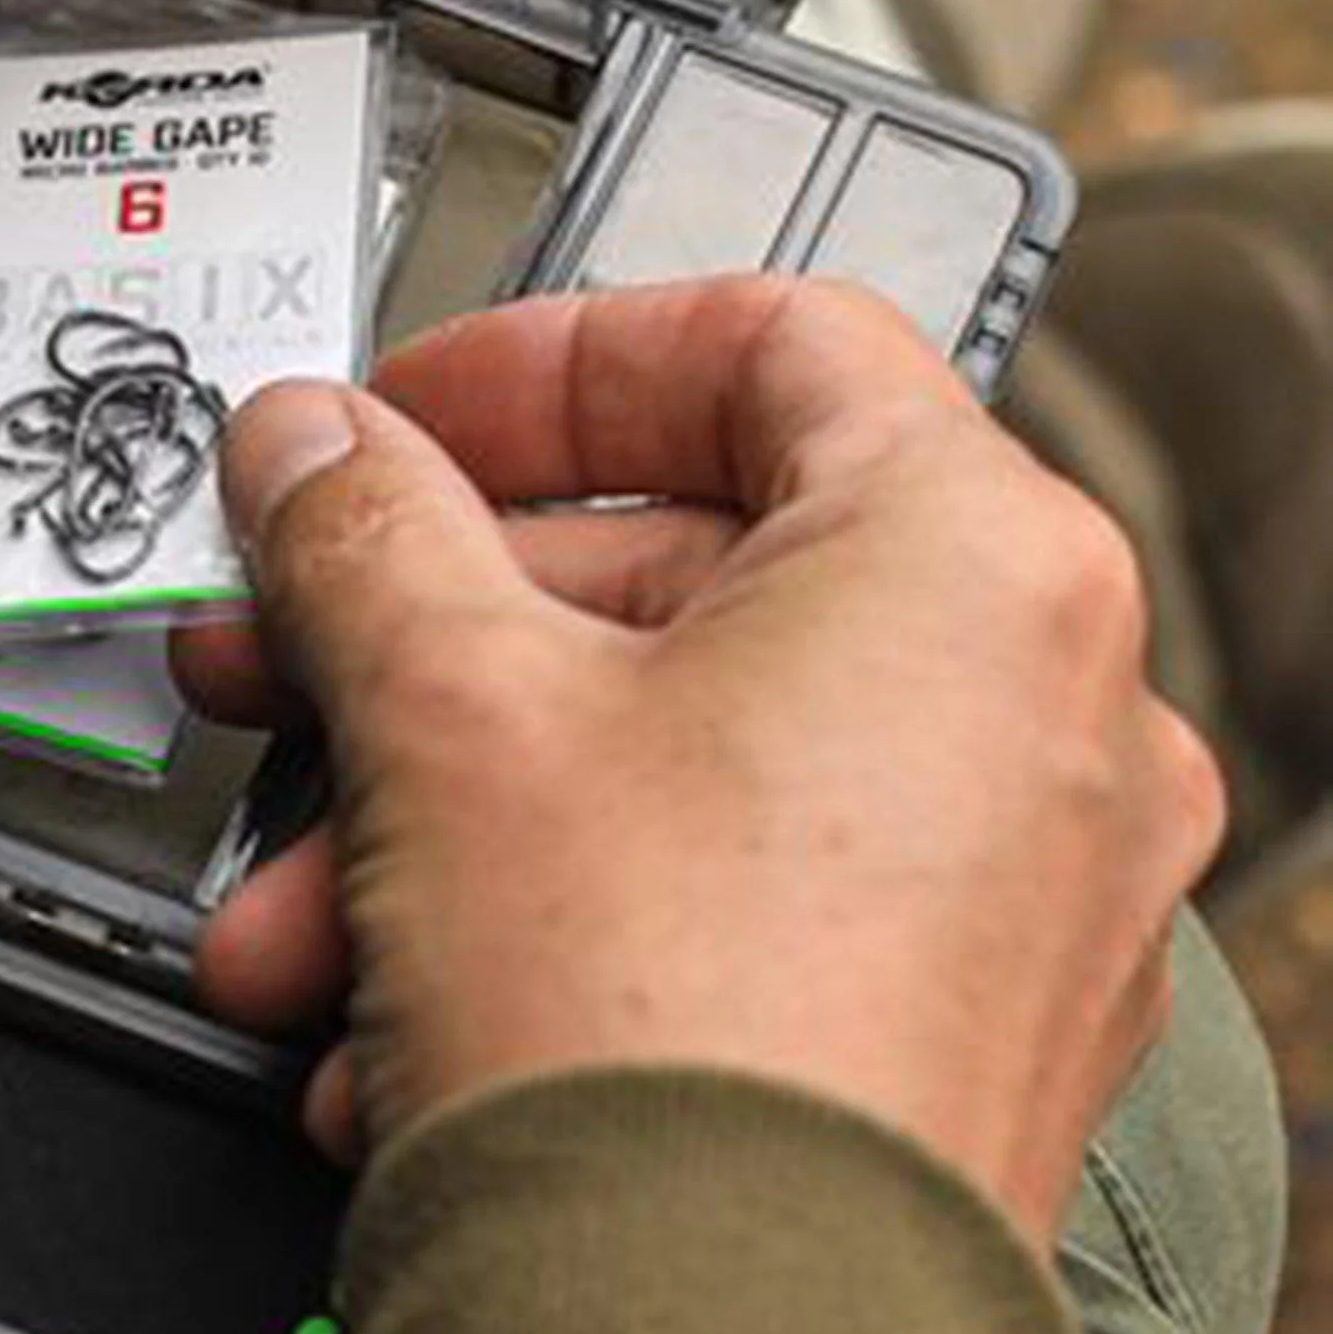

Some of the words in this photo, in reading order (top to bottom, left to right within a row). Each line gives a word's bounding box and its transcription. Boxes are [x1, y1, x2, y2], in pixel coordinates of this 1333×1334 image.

[38, 65, 265, 109] KORDA
[18, 123, 136, 162] WIDE
[152, 113, 276, 153] GAPE
[118, 180, 166, 234] 6
